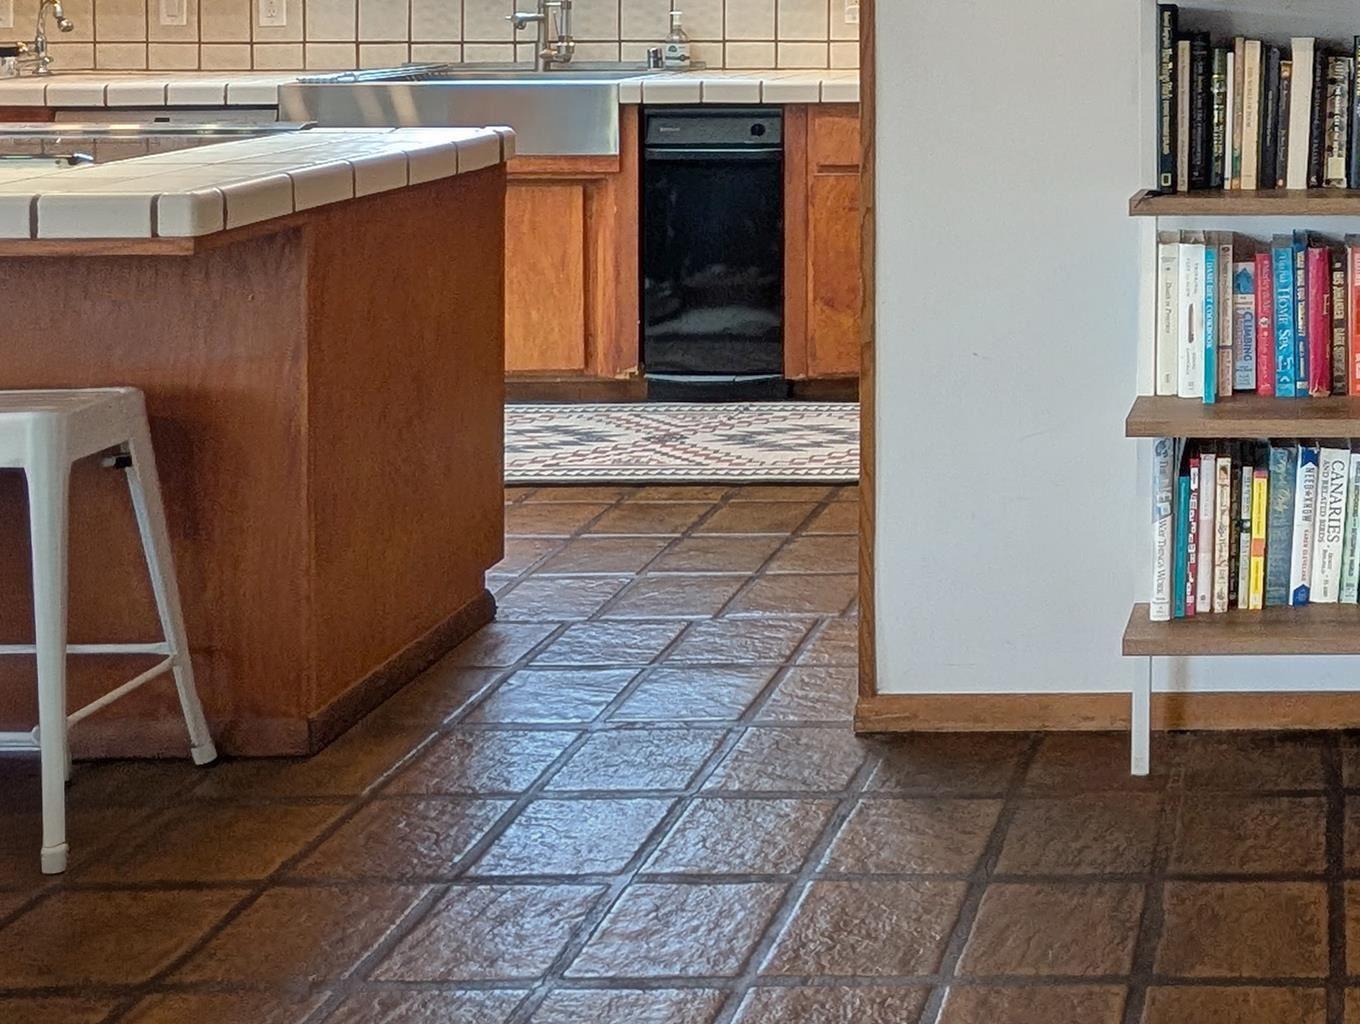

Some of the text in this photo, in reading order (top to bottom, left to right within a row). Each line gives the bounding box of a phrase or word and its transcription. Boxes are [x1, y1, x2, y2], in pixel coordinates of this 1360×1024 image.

[1277, 287, 1289, 325] HOME
[1243, 311, 1253, 362] CLIMBING
[1304, 467, 1315, 490] NEED
[1302, 496, 1313, 522] KNOW
[1319, 480, 1328, 517] RELATED
[1327, 460, 1344, 542] CANARIES
[1318, 519, 1326, 543] BIRDS
